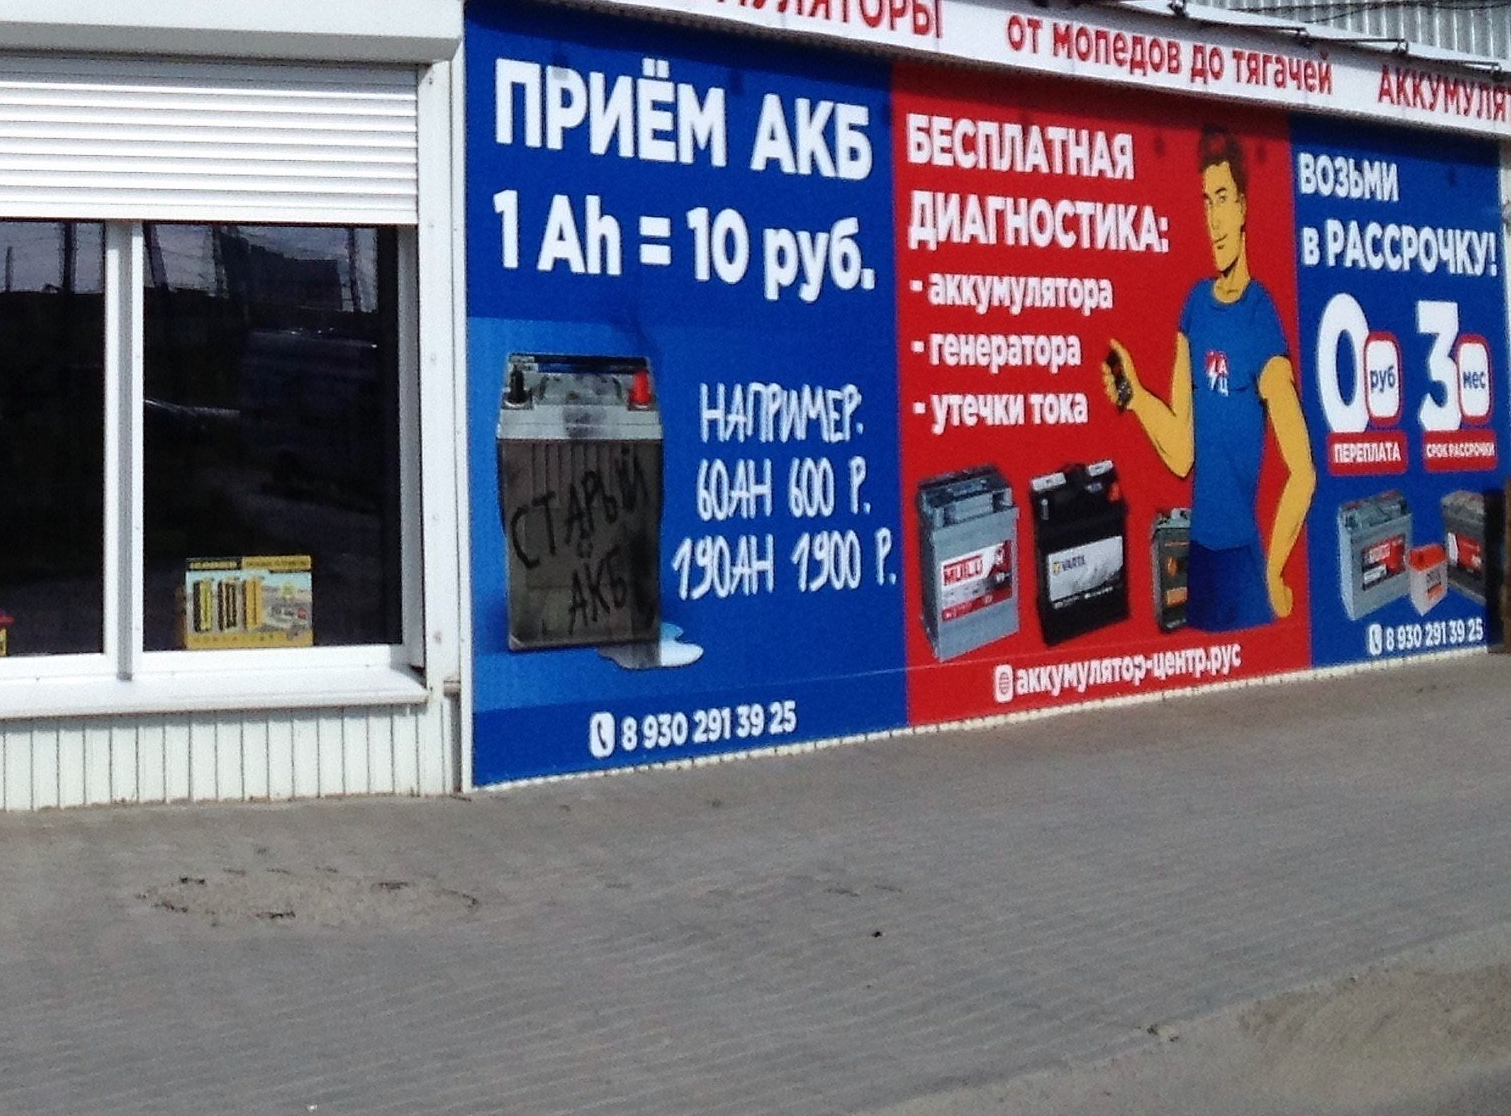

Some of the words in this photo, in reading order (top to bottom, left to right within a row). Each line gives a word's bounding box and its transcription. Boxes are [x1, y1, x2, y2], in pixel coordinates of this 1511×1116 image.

[1378, 64, 1511, 122] АККУМУЛЯ
[495, 58, 726, 166] ПРИЁМ
[750, 93, 872, 181] АКБ
[906, 113, 1134, 179] БЕСПЛАТНАЯ
[1299, 152, 1399, 202] ВОЗЬМИ
[493, 190, 518, 269] 1
[537, 194, 622, 275] Ah
[687, 207, 749, 284] 10
[763, 217, 875, 301] руб.
[908, 190, 1169, 252] ДИАГНОСТИКА:
[1325, 219, 1497, 276] РАССРОЧКУ!
[928, 272, 1113, 316] аккумулятора
[929, 334, 1081, 374] генератора
[1369, 365, 1396, 393] руб
[1462, 371, 1486, 389] мес
[930, 394, 1025, 435] утечки
[1029, 393, 1088, 424] тока
[1333, 442, 1401, 463] ПЕРЕПЛАТА
[788, 457, 835, 518] 600
[791, 530, 861, 592] 1900
[1386, 627, 1395, 651] 8
[1398, 623, 1422, 650] 930
[1425, 621, 1447, 647] 291
[1449, 619, 1466, 644] 39
[1468, 617, 1484, 642] 25
[1015, 643, 1241, 696] аккумулятор-центр.рус
[621, 716, 638, 752] 8
[643, 712, 689, 749] 930
[693, 707, 731, 744] 291
[736, 703, 765, 738] 39
[769, 700, 797, 734] 25
